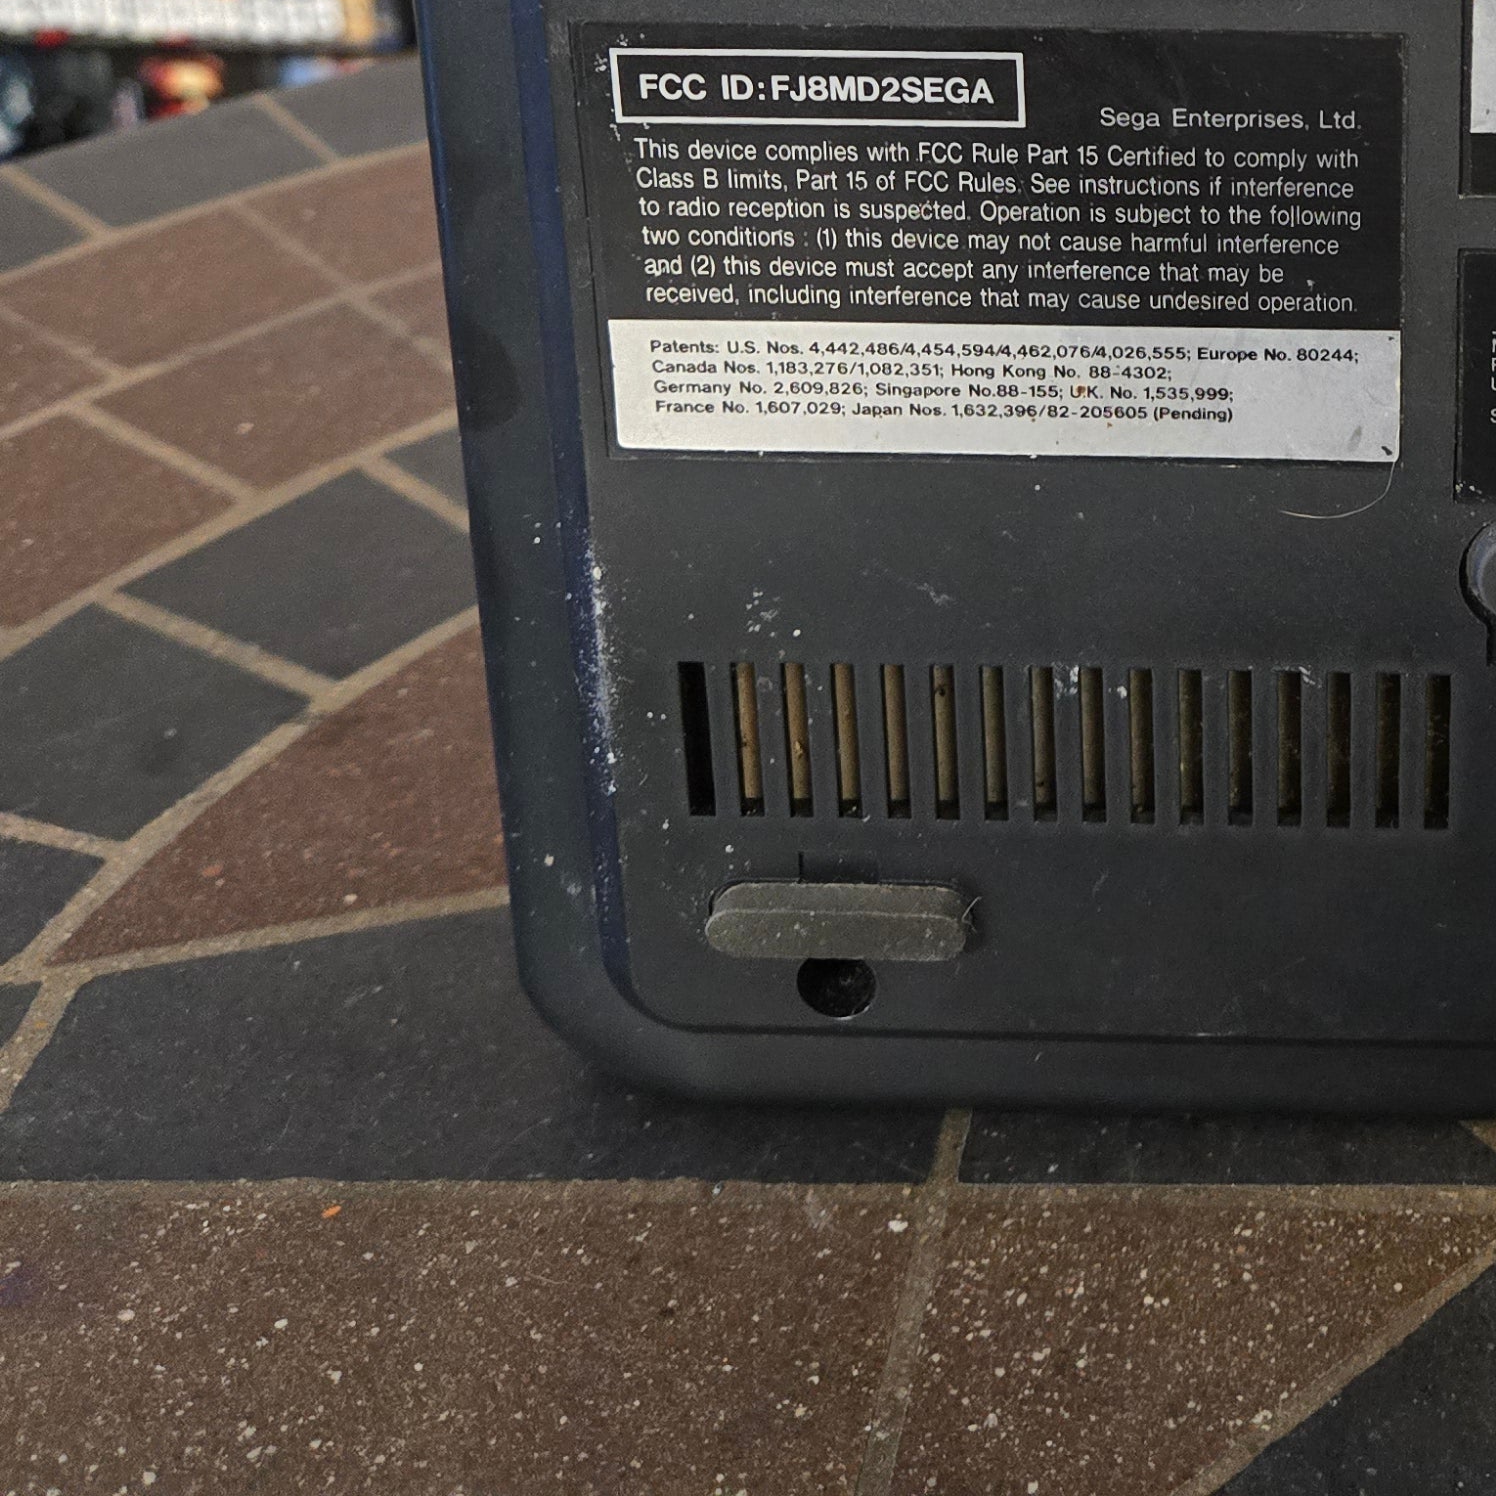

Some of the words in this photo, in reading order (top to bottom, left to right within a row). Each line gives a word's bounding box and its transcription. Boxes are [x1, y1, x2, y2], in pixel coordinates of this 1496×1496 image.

[639, 72, 707, 100] FCC
[721, 74, 994, 104] ID:FJ8MD2SEGA
[1100, 106, 1160, 131] Sega
[1172, 107, 1309, 132] Enterprises,
[1319, 110, 1361, 129] Ltd.
[633, 137, 679, 159] This
[687, 138, 756, 160] device
[765, 140, 858, 165] complies
[866, 141, 909, 162] with
[915, 141, 963, 164] FCC
[972, 142, 1018, 164] Rule
[1027, 143, 1068, 165] Part
[1107, 144, 1195, 167] Certified
[1234, 148, 1307, 172] comply
[1316, 148, 1358, 169] with
[636, 166, 694, 188] Class
[727, 168, 787, 192] limits,
[796, 168, 838, 191] Part
[904, 170, 949, 192] FCC
[1030, 172, 1070, 194] See
[1079, 175, 1200, 196] instructions
[1231, 176, 1354, 198] interference
[668, 196, 720, 217] radio
[728, 197, 825, 221] reception
[859, 200, 971, 223] suspected.
[980, 200, 1080, 225] Operation
[1115, 203, 1191, 227] subject
[1228, 204, 1261, 225] the
[1269, 204, 1360, 230] following
[641, 225, 680, 245] two
[688, 225, 795, 247] conditions
[845, 227, 882, 248] this
[891, 228, 959, 250] device
[968, 233, 1010, 254] may
[1019, 232, 1051, 251] not
[1059, 235, 1122, 252] cause
[1131, 232, 1207, 253] harmful
[1217, 233, 1339, 255] interference
[644, 254, 682, 276] and
[722, 254, 761, 276] this
[769, 255, 836, 277] device
[845, 258, 894, 277] must
[903, 259, 973, 282] accept
[982, 263, 1018, 283] any
[1028, 259, 1150, 281] interference
[1159, 261, 1199, 282] that
[1207, 266, 1249, 287] may
[646, 283, 739, 305] received,
[748, 283, 840, 309] including
[849, 284, 972, 307] interference
[979, 287, 1020, 308] that
[1028, 292, 1069, 312] may
[1078, 293, 1140, 309] cause
[1149, 290, 1249, 310] undesired
[1258, 293, 1358, 314] operation.
[650, 339, 719, 353] Patents:
[727, 340, 760, 354] U.S.
[1197, 346, 1257, 363] Europe
[1296, 347, 1358, 364] 80244;
[652, 359, 717, 374] Canada
[766, 361, 944, 378] 1,183,276/1,082,351;
[951, 363, 995, 380] Hong
[1002, 364, 1046, 381] Kong
[1088, 365, 1172, 381] 88-4302;
[653, 379, 731, 396] Germany
[773, 381, 868, 397] 2,609,826;
[875, 382, 961, 399] Singapore
[1143, 386, 1233, 403] 1,535,999;
[655, 399, 715, 413] France
[755, 400, 845, 416] 1,607,029;
[851, 402, 902, 418] Japan
[1153, 406, 1233, 423] (Pending)
